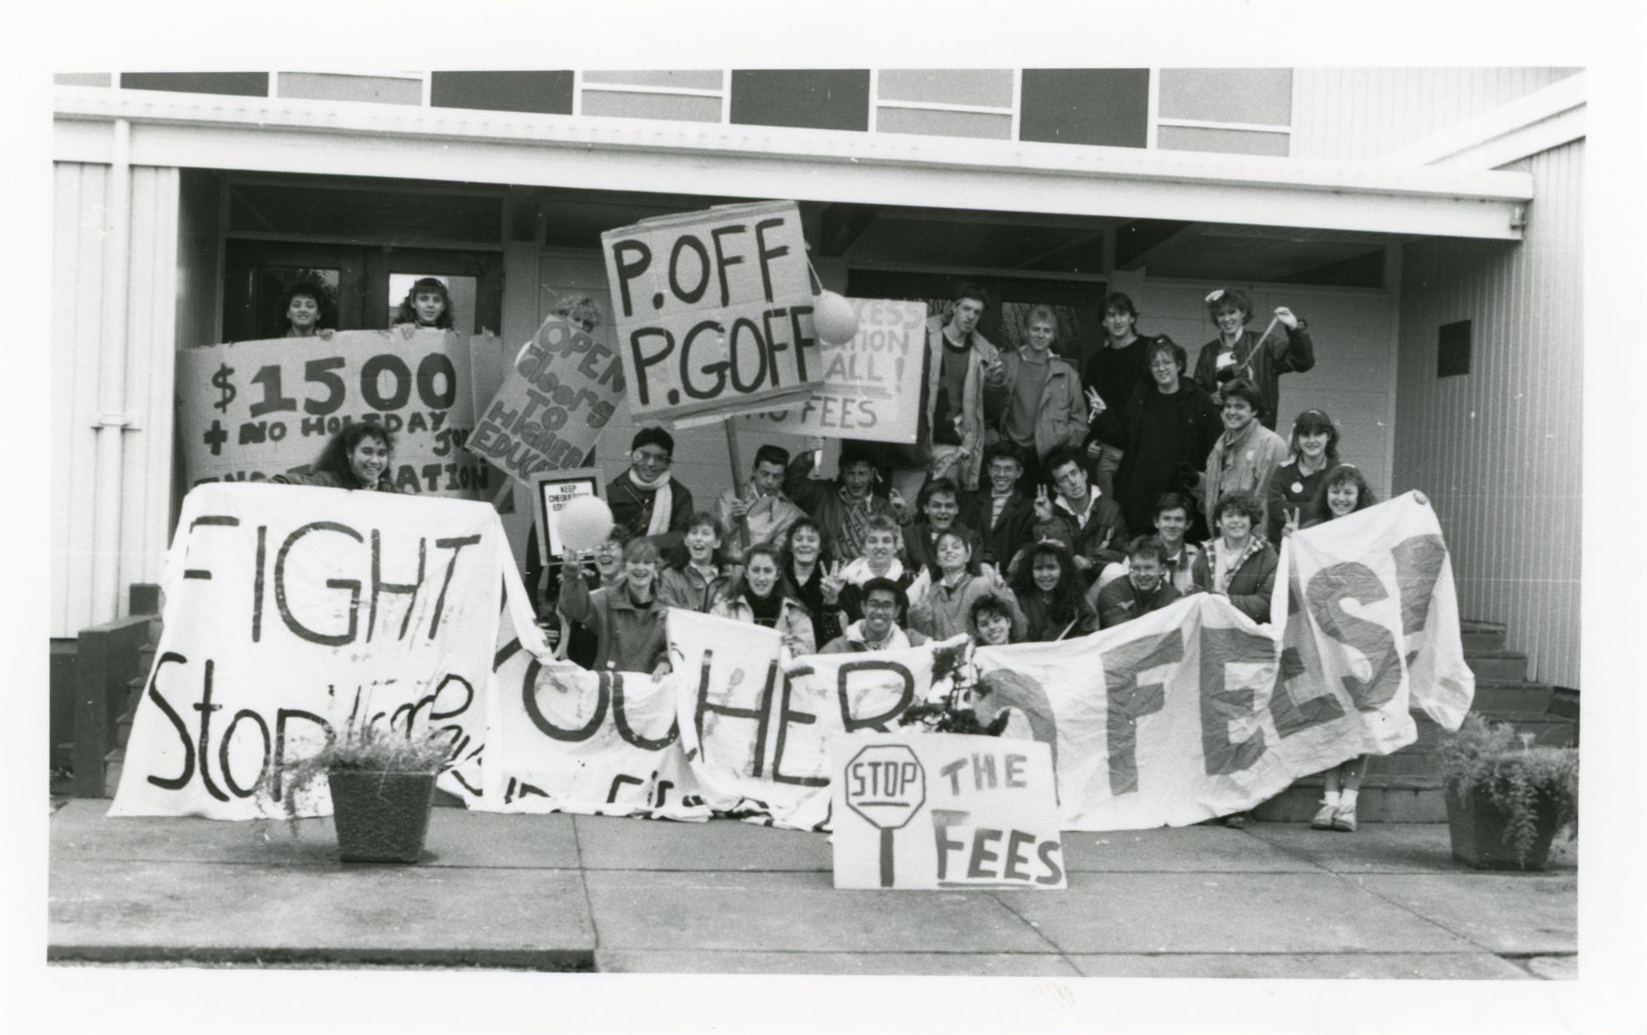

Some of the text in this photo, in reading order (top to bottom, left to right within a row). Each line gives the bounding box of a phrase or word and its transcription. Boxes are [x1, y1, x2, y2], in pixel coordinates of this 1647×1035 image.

[612, 217, 790, 318] P.OFF
[853, 301, 926, 332] CESS
[211, 352, 457, 418] $1500
[538, 321, 627, 393] OPEN
[630, 305, 815, 406] P.GOFF
[238, 420, 287, 446] NO
[487, 400, 584, 470] HIGHER
[526, 388, 569, 431] TO
[801, 395, 879, 430] FEES
[560, 484, 577, 493] KEEP
[183, 515, 482, 647] FIGHT
[850, 753, 1028, 797] STOP THE
[931, 809, 1063, 885] FEES
